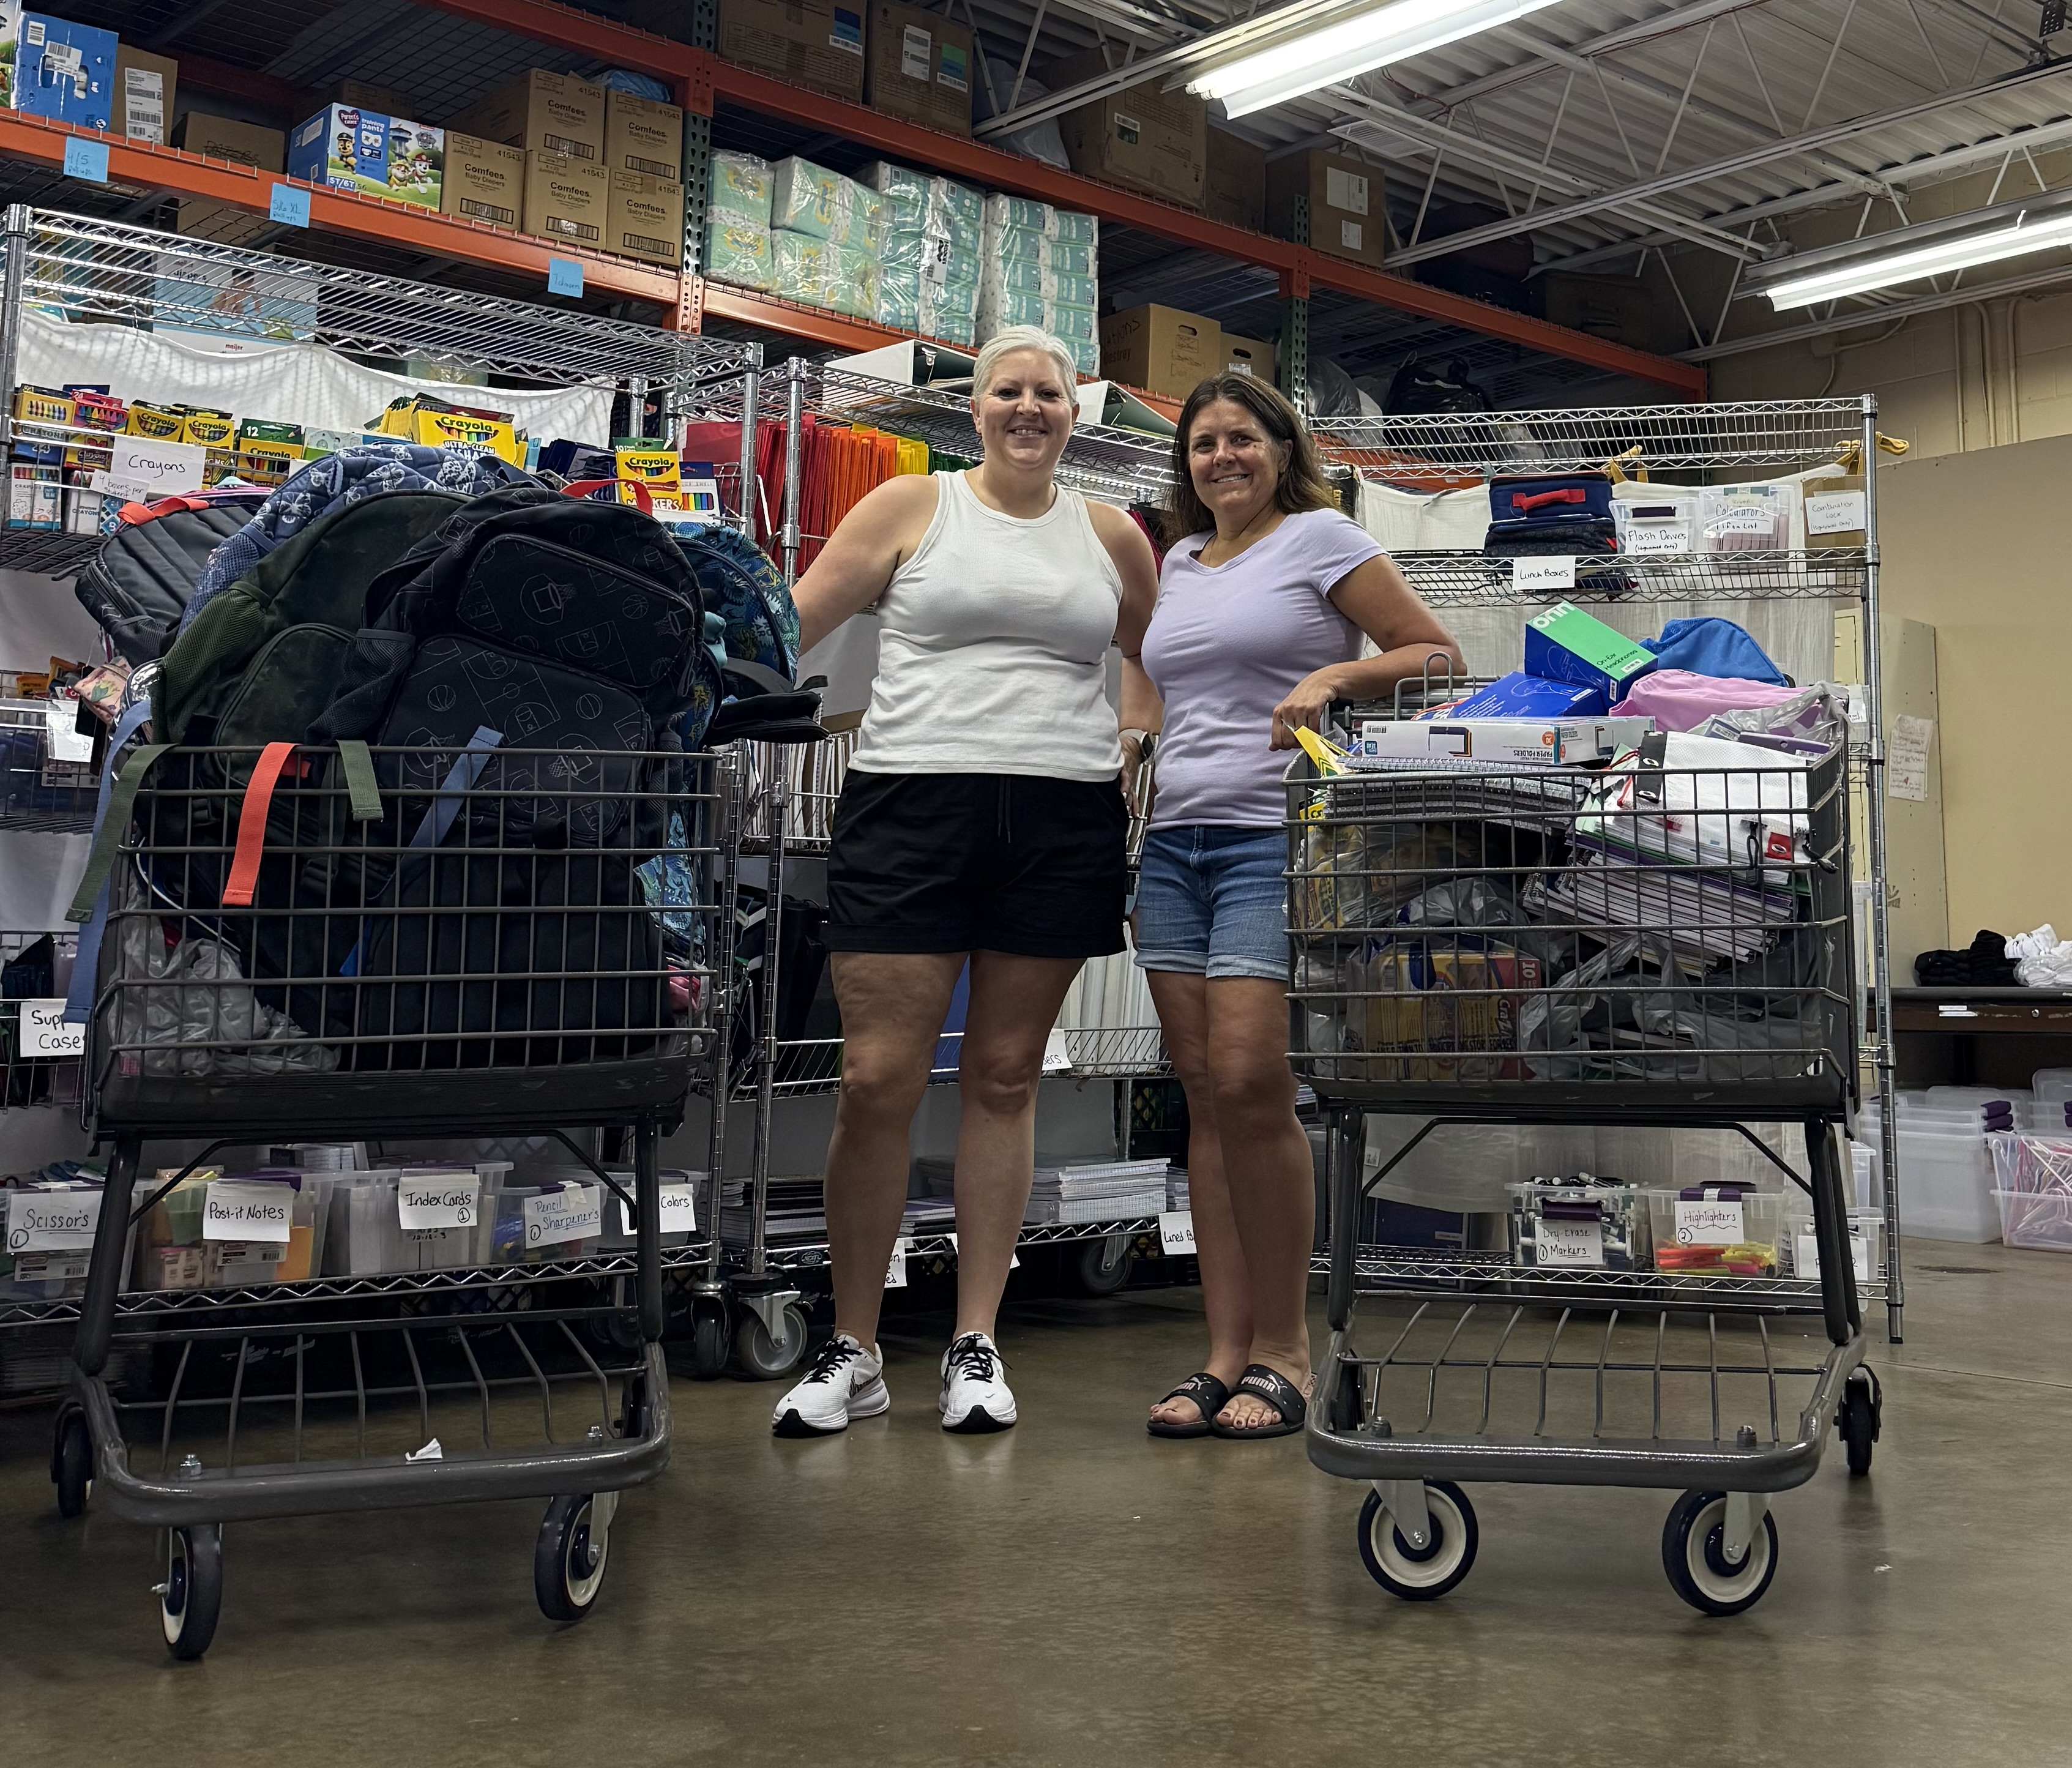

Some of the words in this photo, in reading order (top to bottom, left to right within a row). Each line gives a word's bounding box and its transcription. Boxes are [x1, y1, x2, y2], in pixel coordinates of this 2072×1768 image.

[548, 99, 586, 116] Comfees
[362, 118, 385, 128] training
[362, 124, 384, 133] pants
[628, 122, 668, 138] Comfees
[464, 163, 505, 180] Comfees
[550, 182, 590, 198] Comfees
[627, 199, 666, 214] Comfees
[141, 412, 176, 428] Crayola
[192, 420, 226, 431] Crayola
[440, 416, 493, 432] Crayola
[246, 425, 259, 437] 12
[250, 447, 291, 458] Crayola
[444, 441, 495, 455] ULTRA-CLEAN
[129, 455, 186, 479] Crayons
[629, 457, 670, 467] Crayola
[99, 474, 105, 485] 4
[627, 498, 680, 510] MKERS
[1628, 529, 1656, 542] Flash
[1660, 529, 1687, 540] Drives
[1519, 569, 1543, 580] Lunch
[1544, 568, 1569, 578] Boxes
[1532, 602, 1577, 629] onn
[1522, 961, 1536, 979] 10
[39, 1033, 81, 1049] Case
[405, 1192, 441, 1207] Index
[442, 1191, 472, 1207] Cards
[535, 1195, 562, 1213] Pencil
[660, 1195, 690, 1208] Colors
[209, 1201, 244, 1220] Post-it
[246, 1204, 284, 1220] Notes
[1683, 1209, 1737, 1228] Highlighters
[1163, 1230, 1184, 1243] Lined
[1550, 1244, 1587, 1256] Markers
[1240, 1376, 1276, 1393] PUMA
